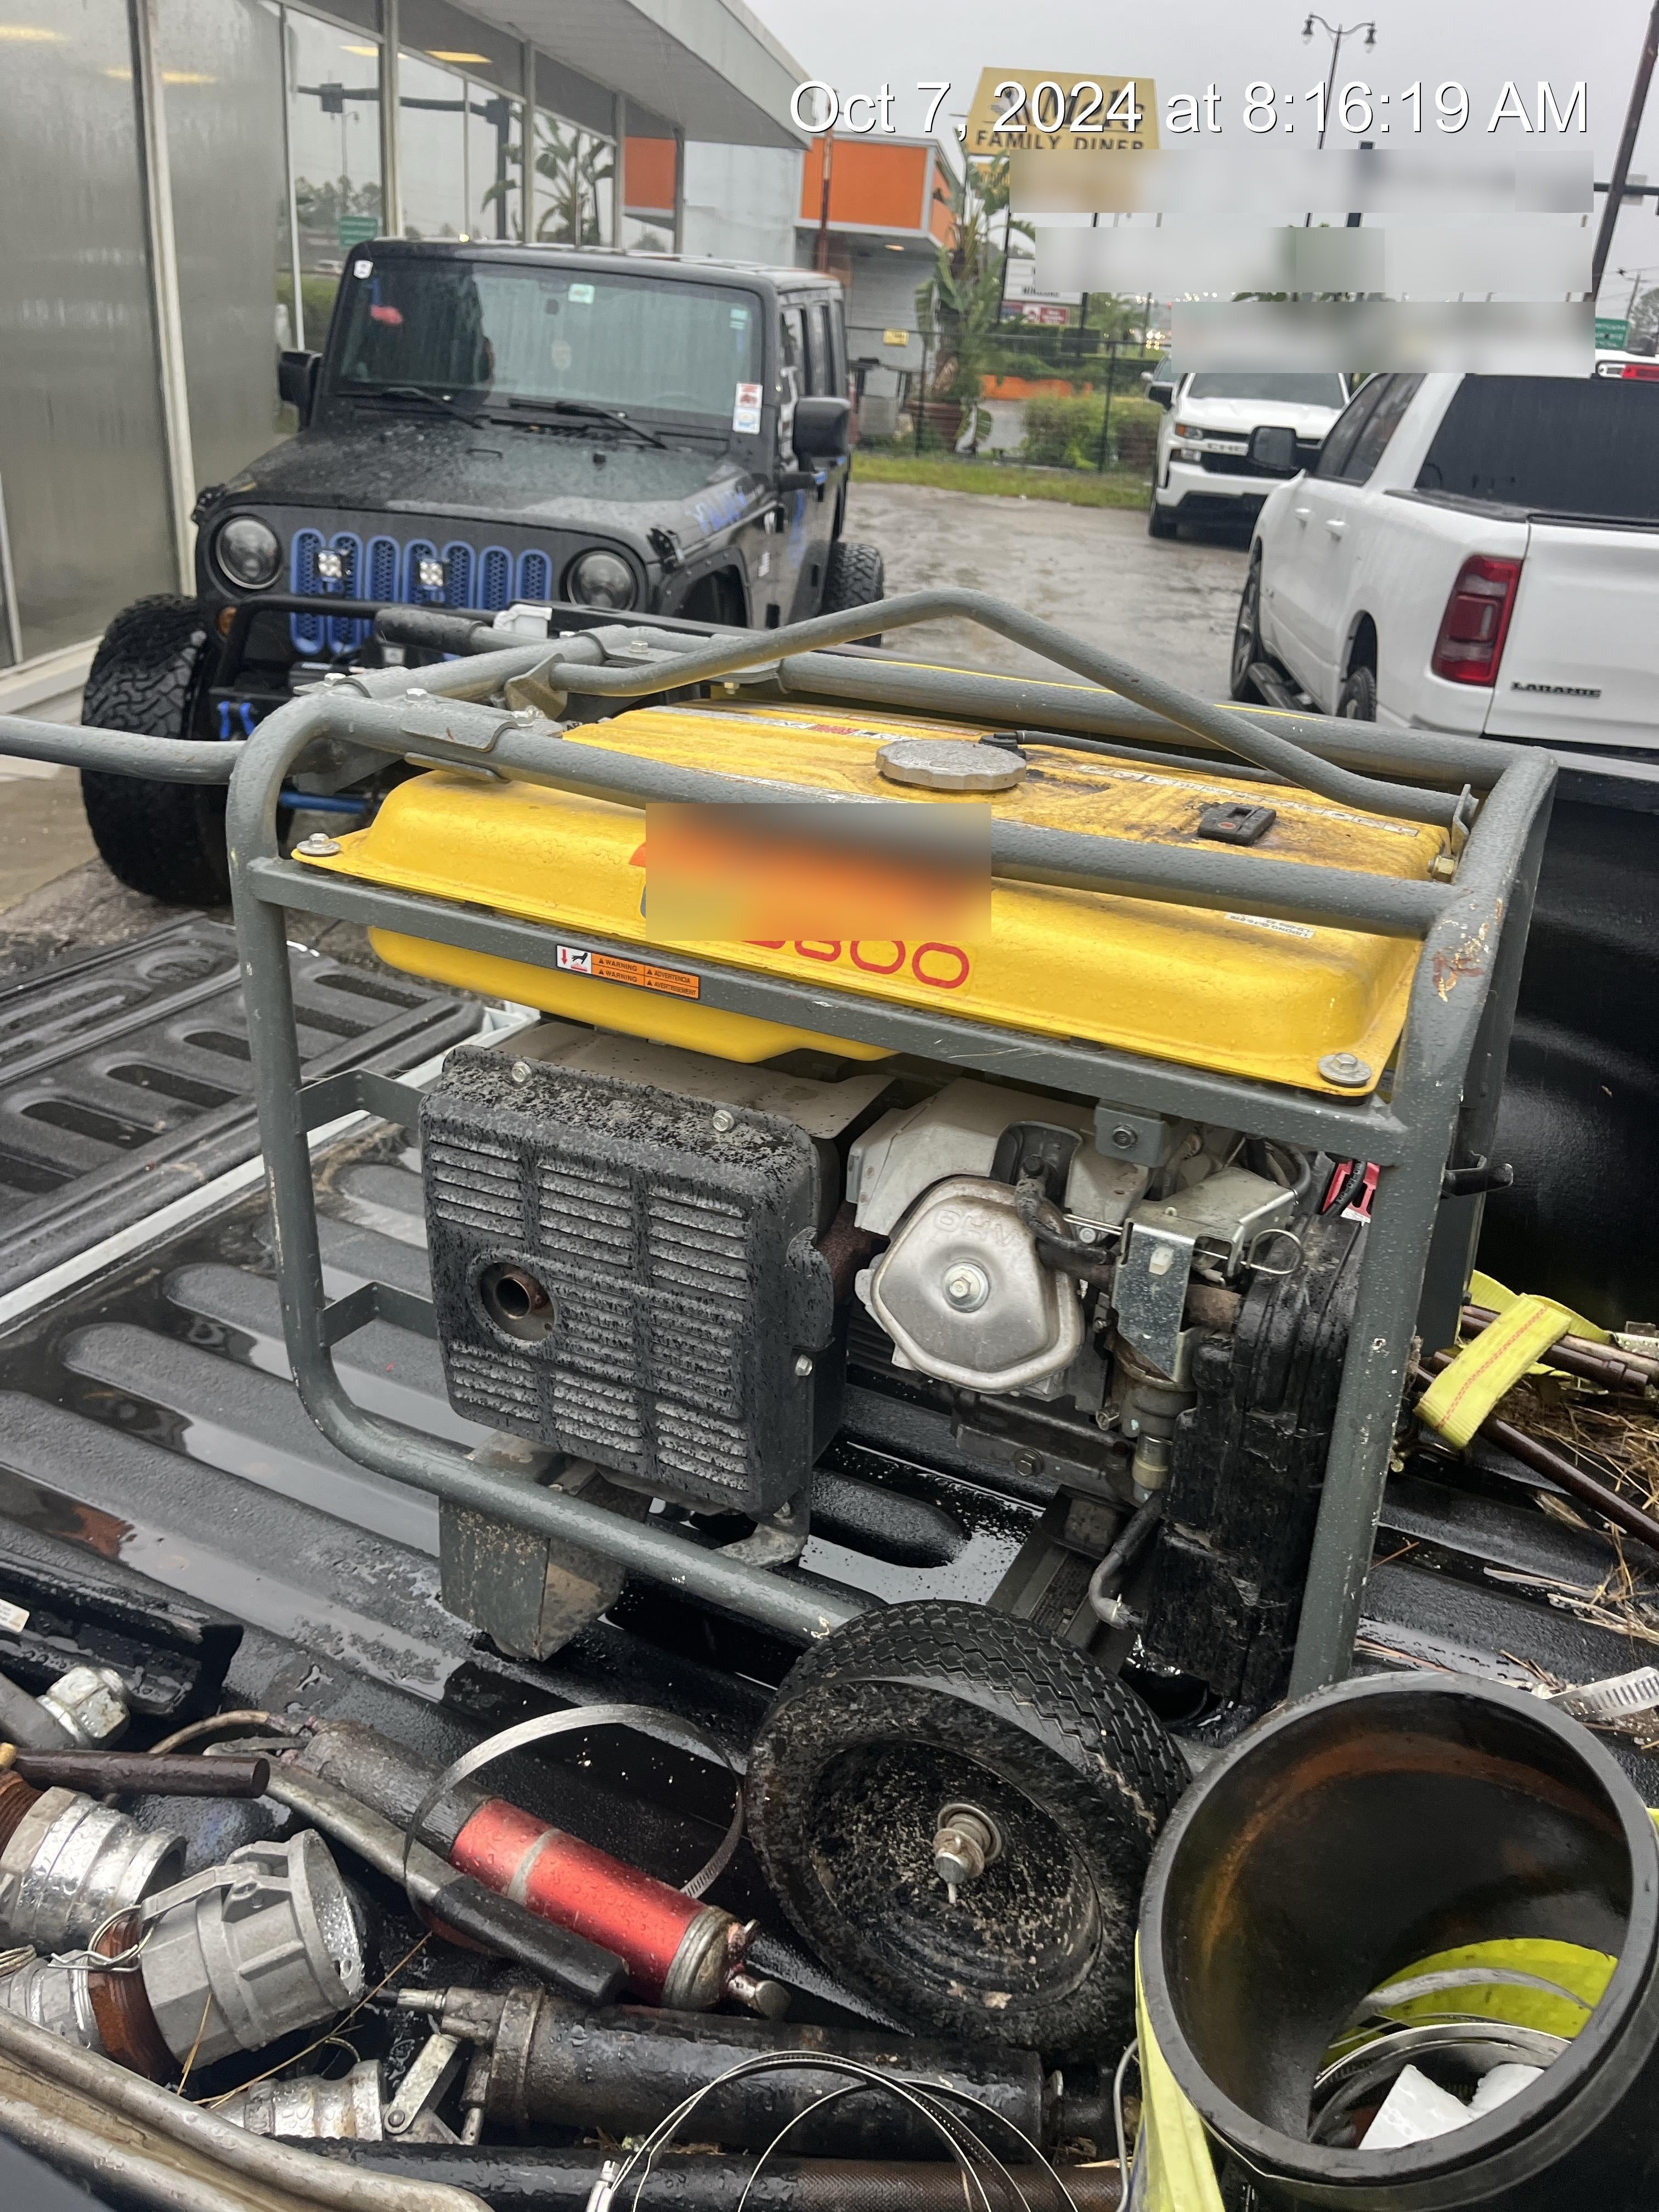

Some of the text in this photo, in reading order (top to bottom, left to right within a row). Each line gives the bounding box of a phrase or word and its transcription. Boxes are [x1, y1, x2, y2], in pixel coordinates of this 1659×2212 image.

[975, 129, 1145, 150] FAMILY DINER
[1511, 681, 1602, 699] LARAMIE
[605, 960, 637, 972] WARNING
[606, 970, 637, 983] WARNING
[654, 970, 691, 983] ADVERTENCIA
